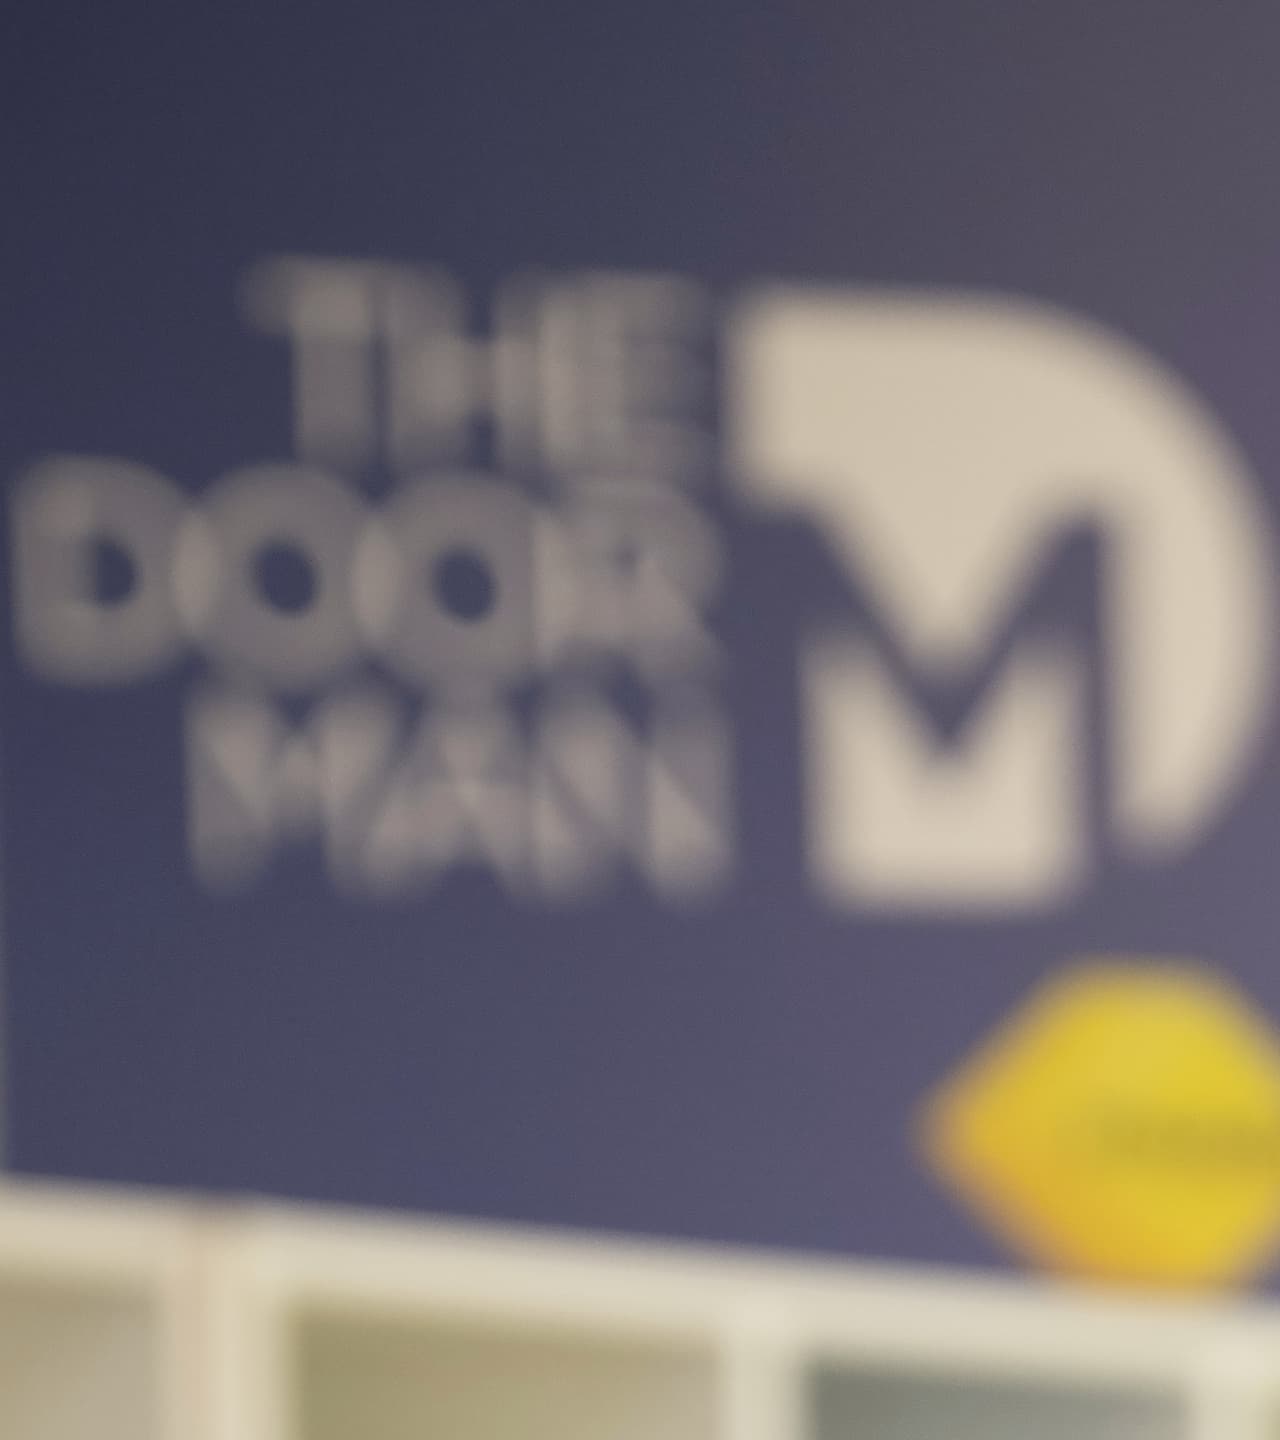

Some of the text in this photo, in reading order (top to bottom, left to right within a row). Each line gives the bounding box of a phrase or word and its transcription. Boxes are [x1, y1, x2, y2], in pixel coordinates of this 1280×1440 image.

[248, 260, 712, 478] THE
[18, 458, 726, 688] DOOR
[192, 688, 734, 900] MAN
